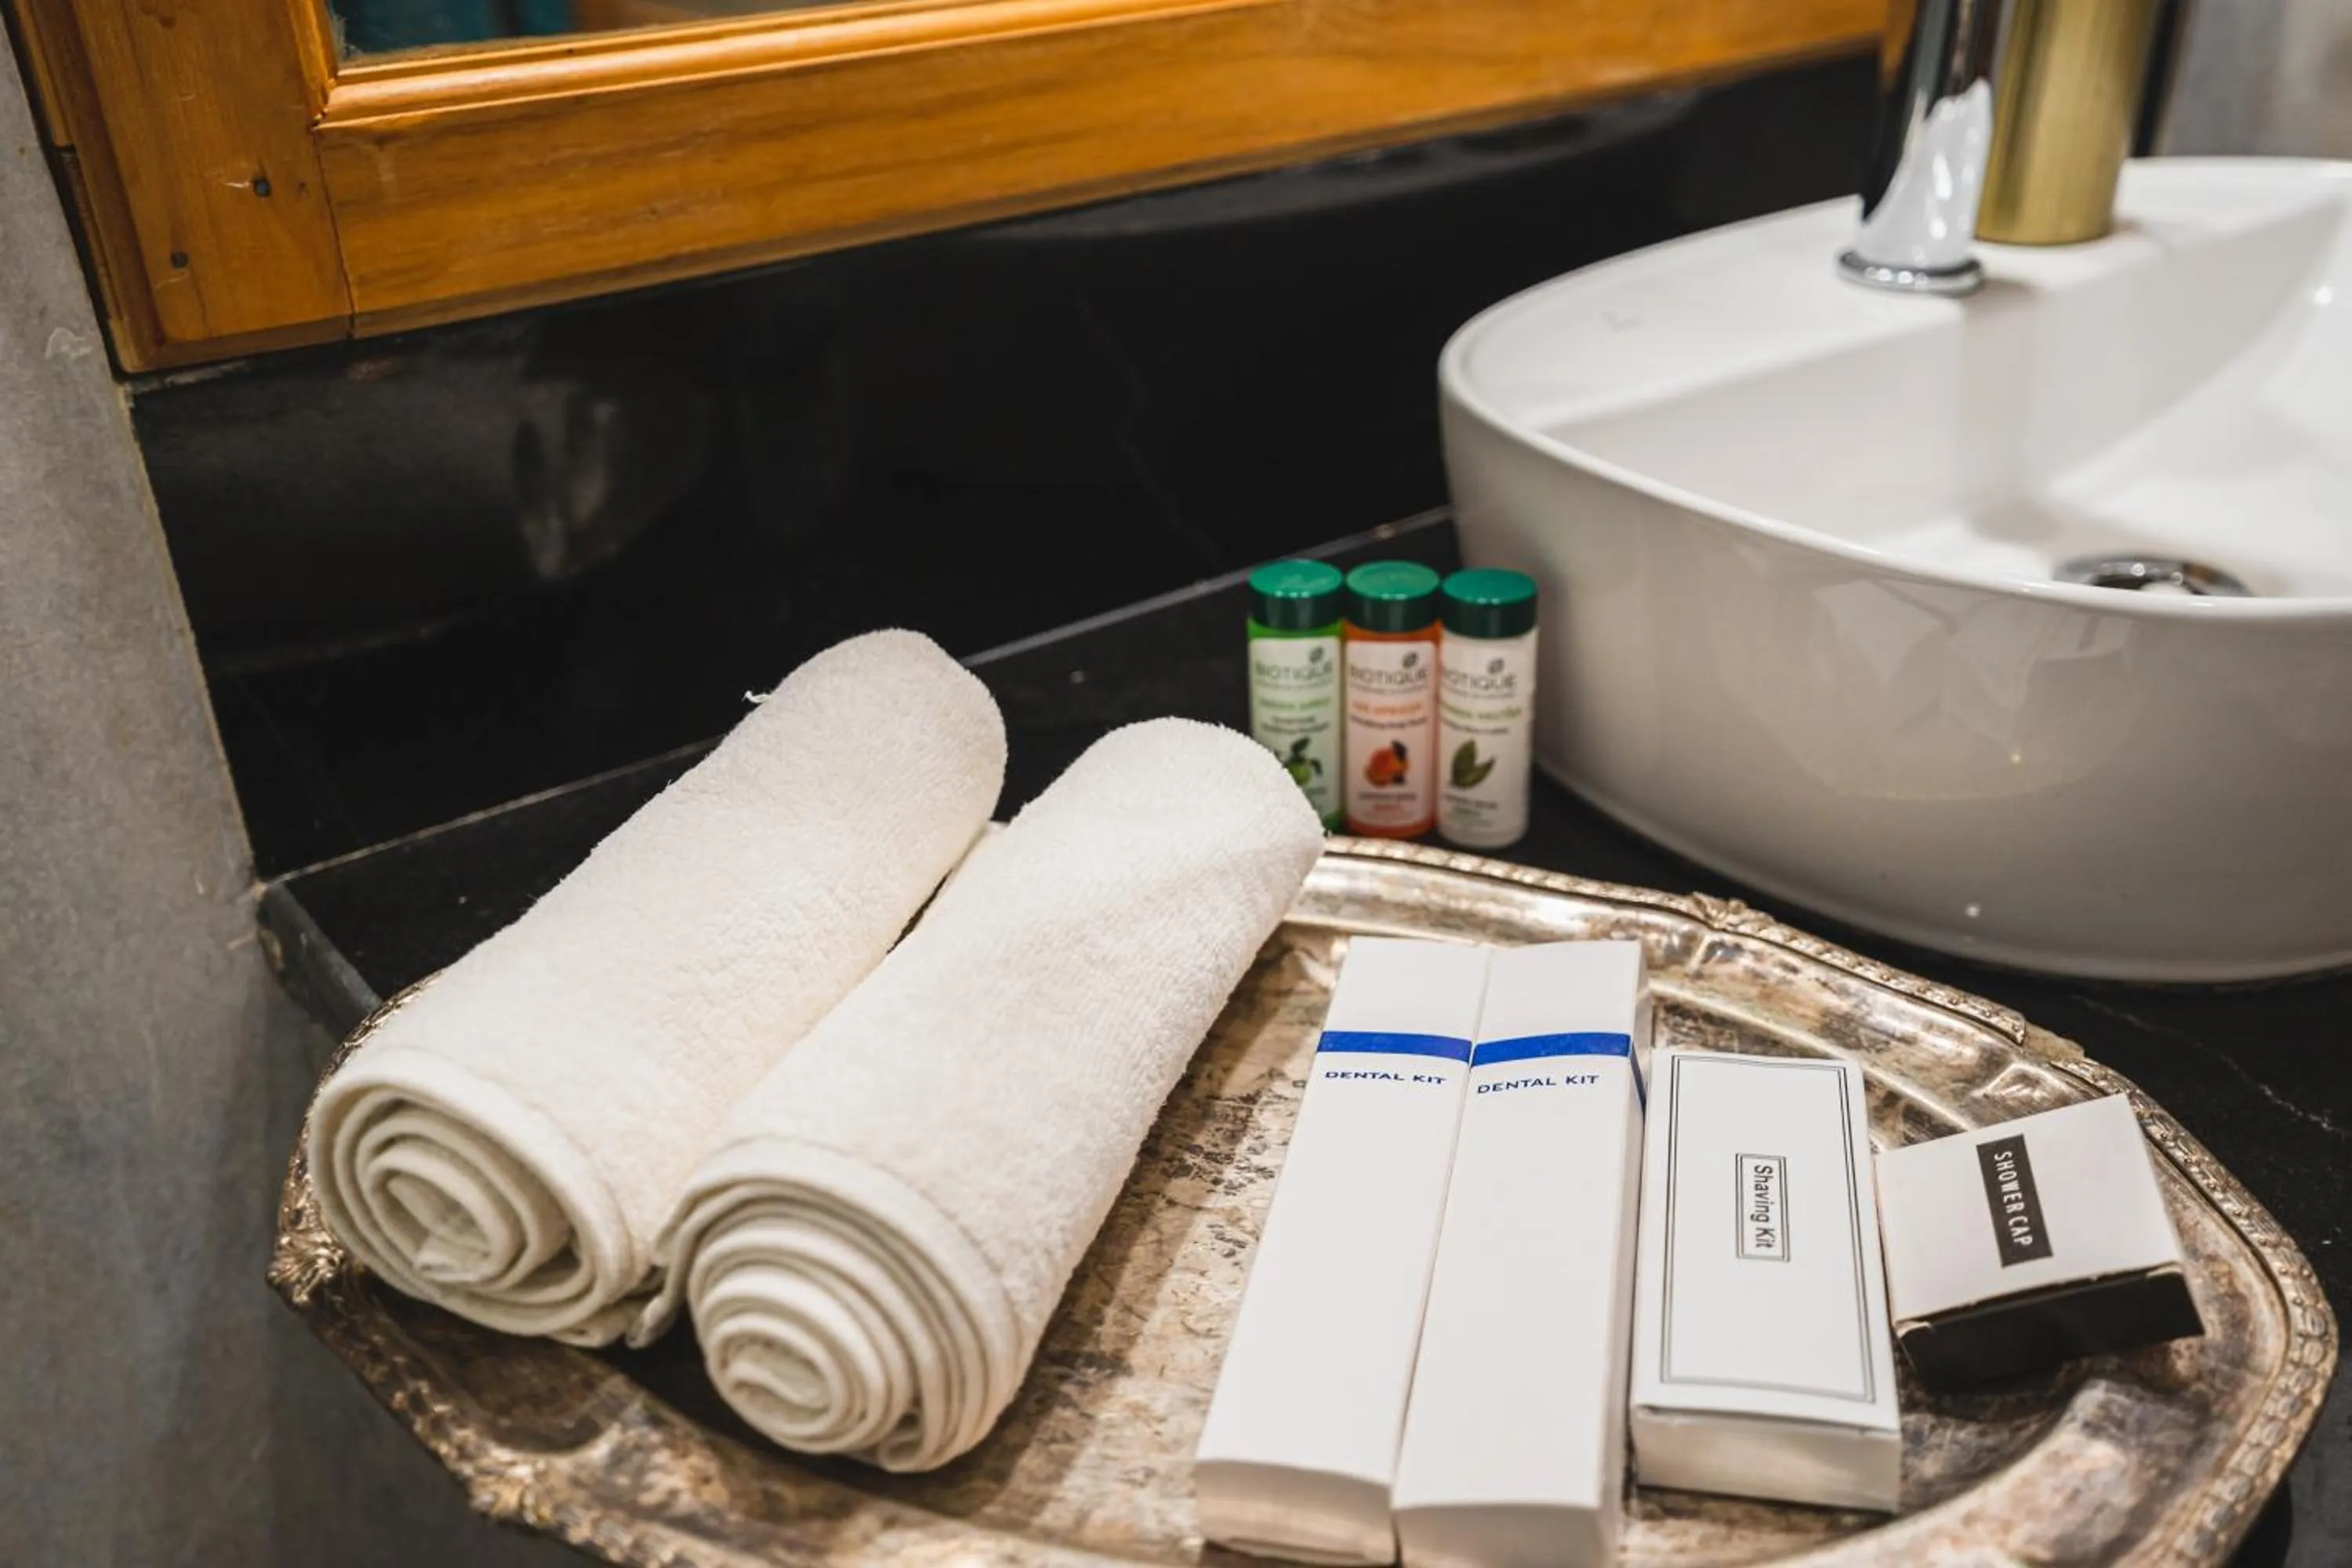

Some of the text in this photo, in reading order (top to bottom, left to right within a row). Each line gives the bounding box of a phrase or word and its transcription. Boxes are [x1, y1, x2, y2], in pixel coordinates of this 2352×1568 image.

[1441, 668, 1518, 691] IOTIQUE
[1325, 1071, 1446, 1084] DENTAL KIT
[1477, 1075, 1599, 1094] DENTAL KIT
[1750, 1165, 1776, 1248] Shaving Kit
[1994, 1151, 2033, 1245] SHOWER CAP
